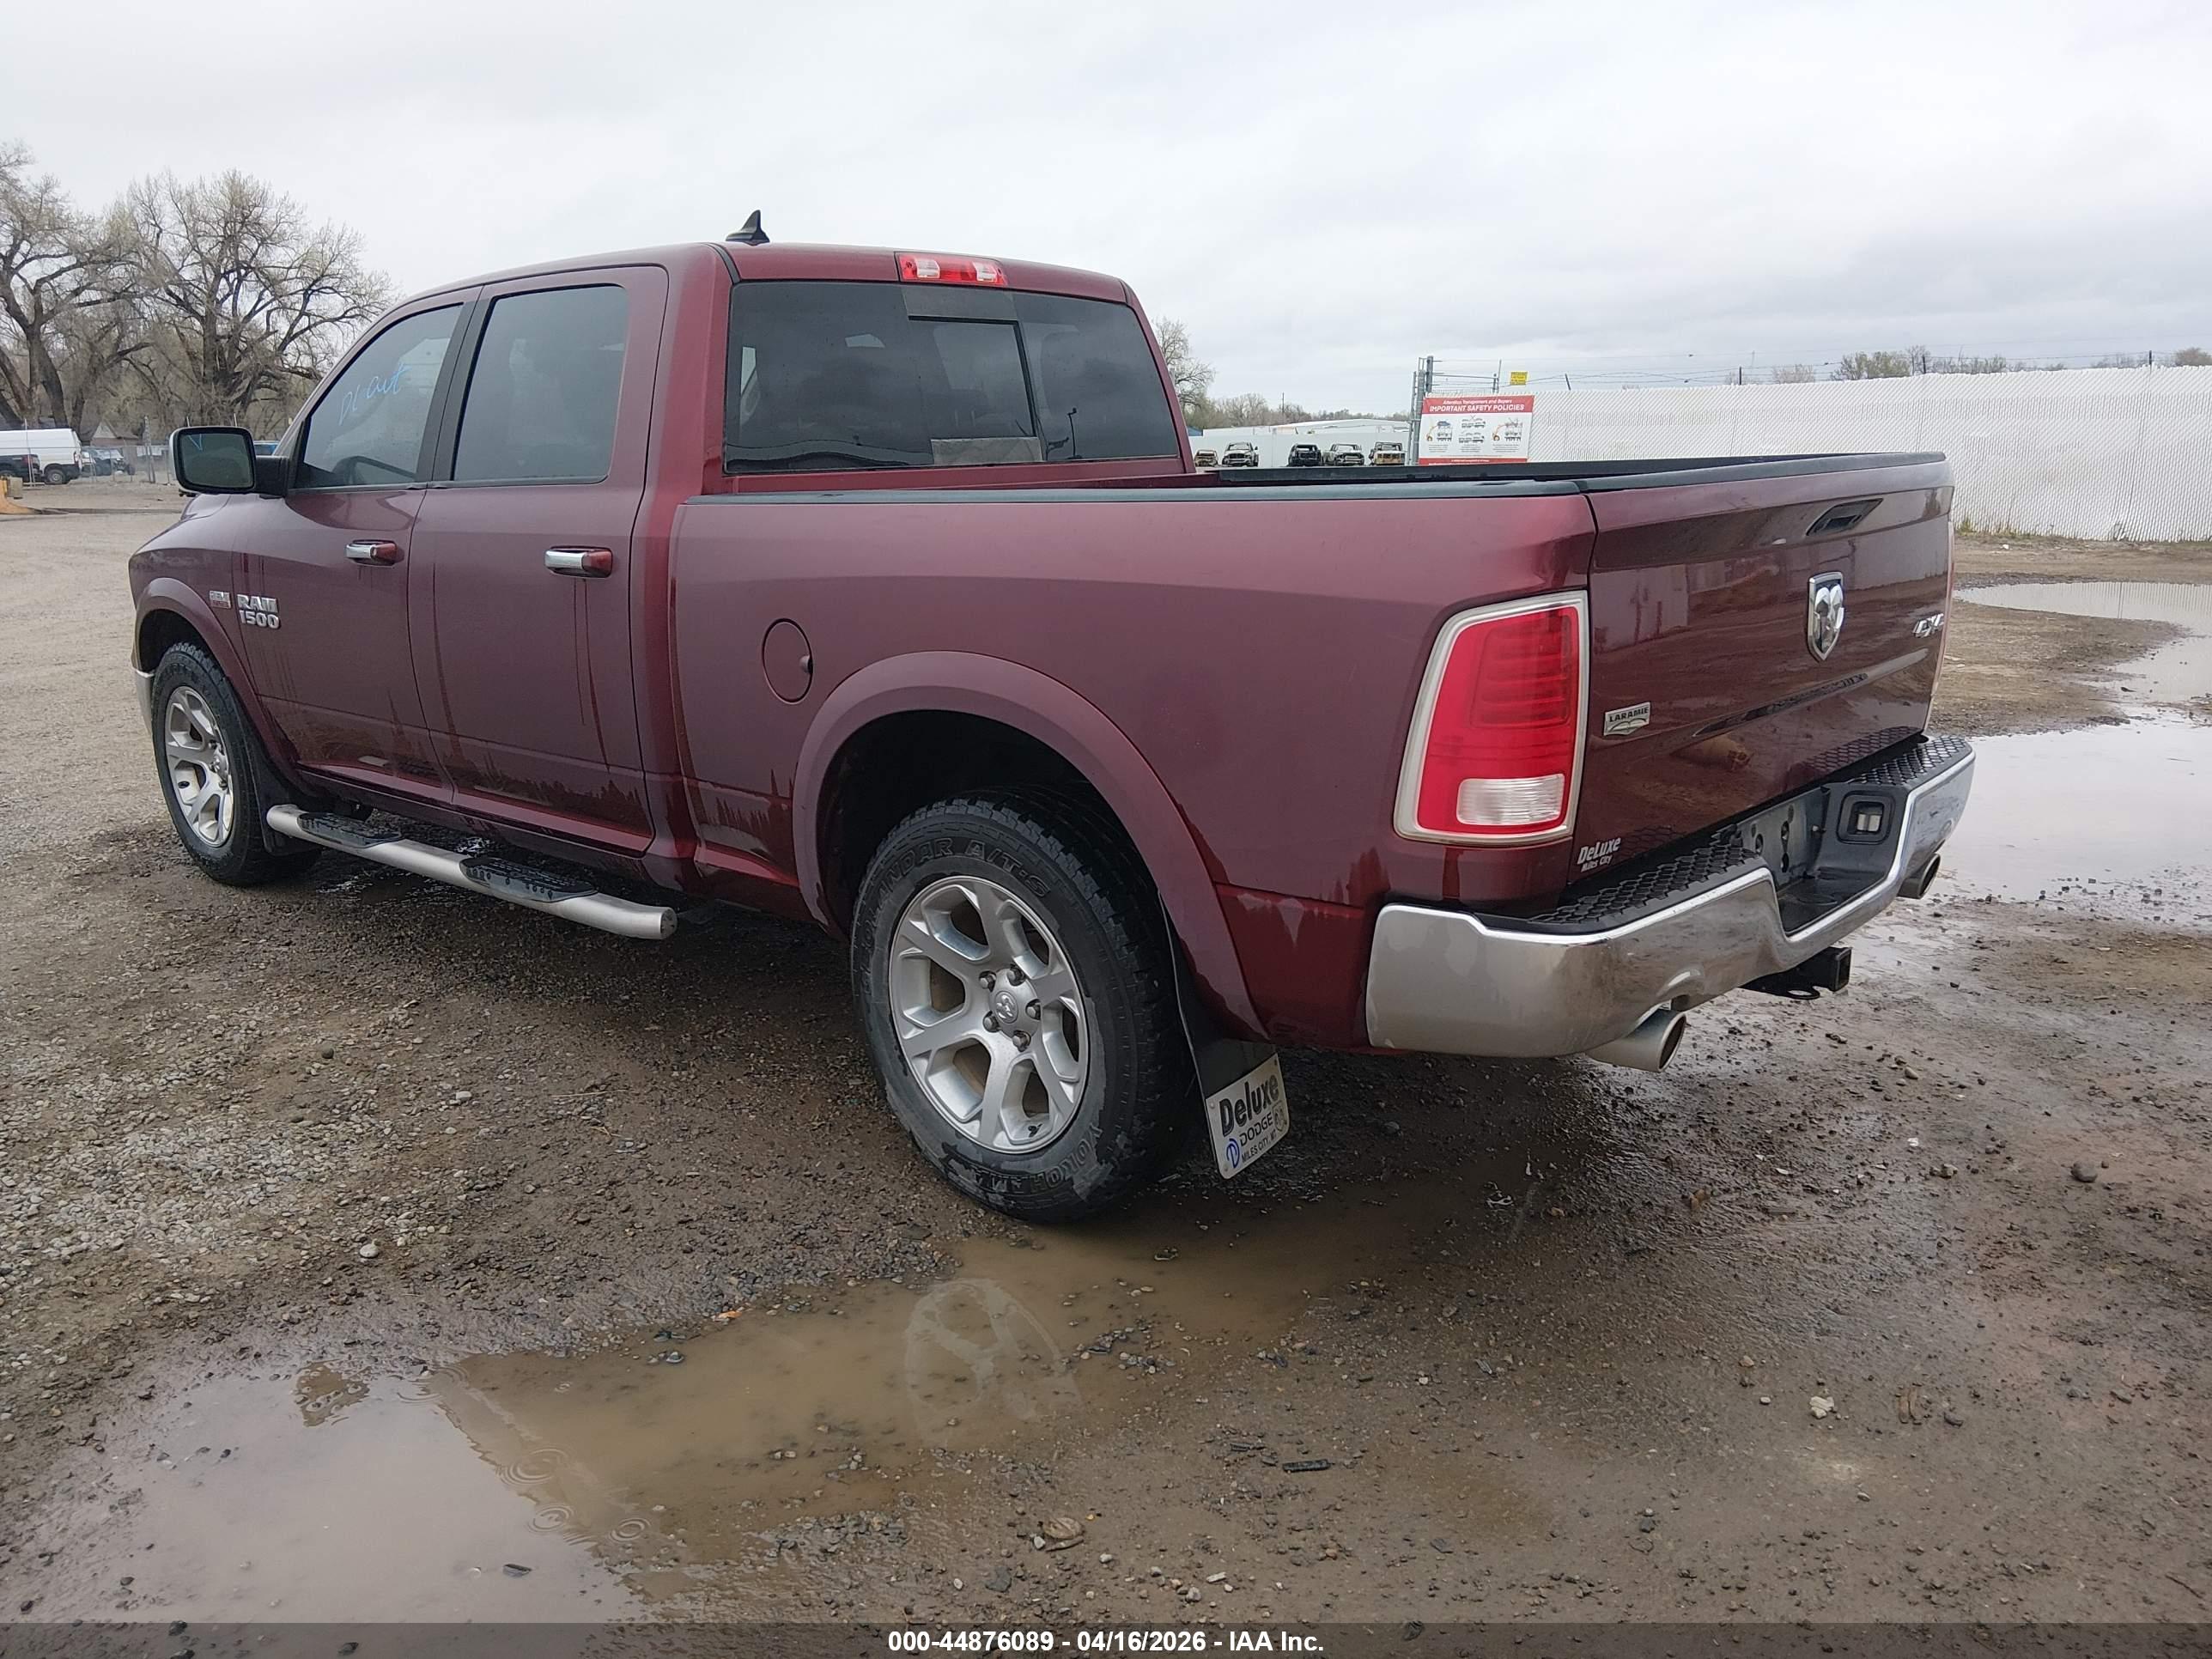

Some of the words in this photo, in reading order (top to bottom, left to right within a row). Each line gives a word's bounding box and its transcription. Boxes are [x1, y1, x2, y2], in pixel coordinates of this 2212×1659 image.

[237, 593, 278, 613] RAM
[239, 610, 281, 629] 1500
[1609, 707, 1649, 722] LARAMIE
[1219, 1074, 1279, 1138] Deluxe
[1239, 1112, 1273, 1147] DODGE
